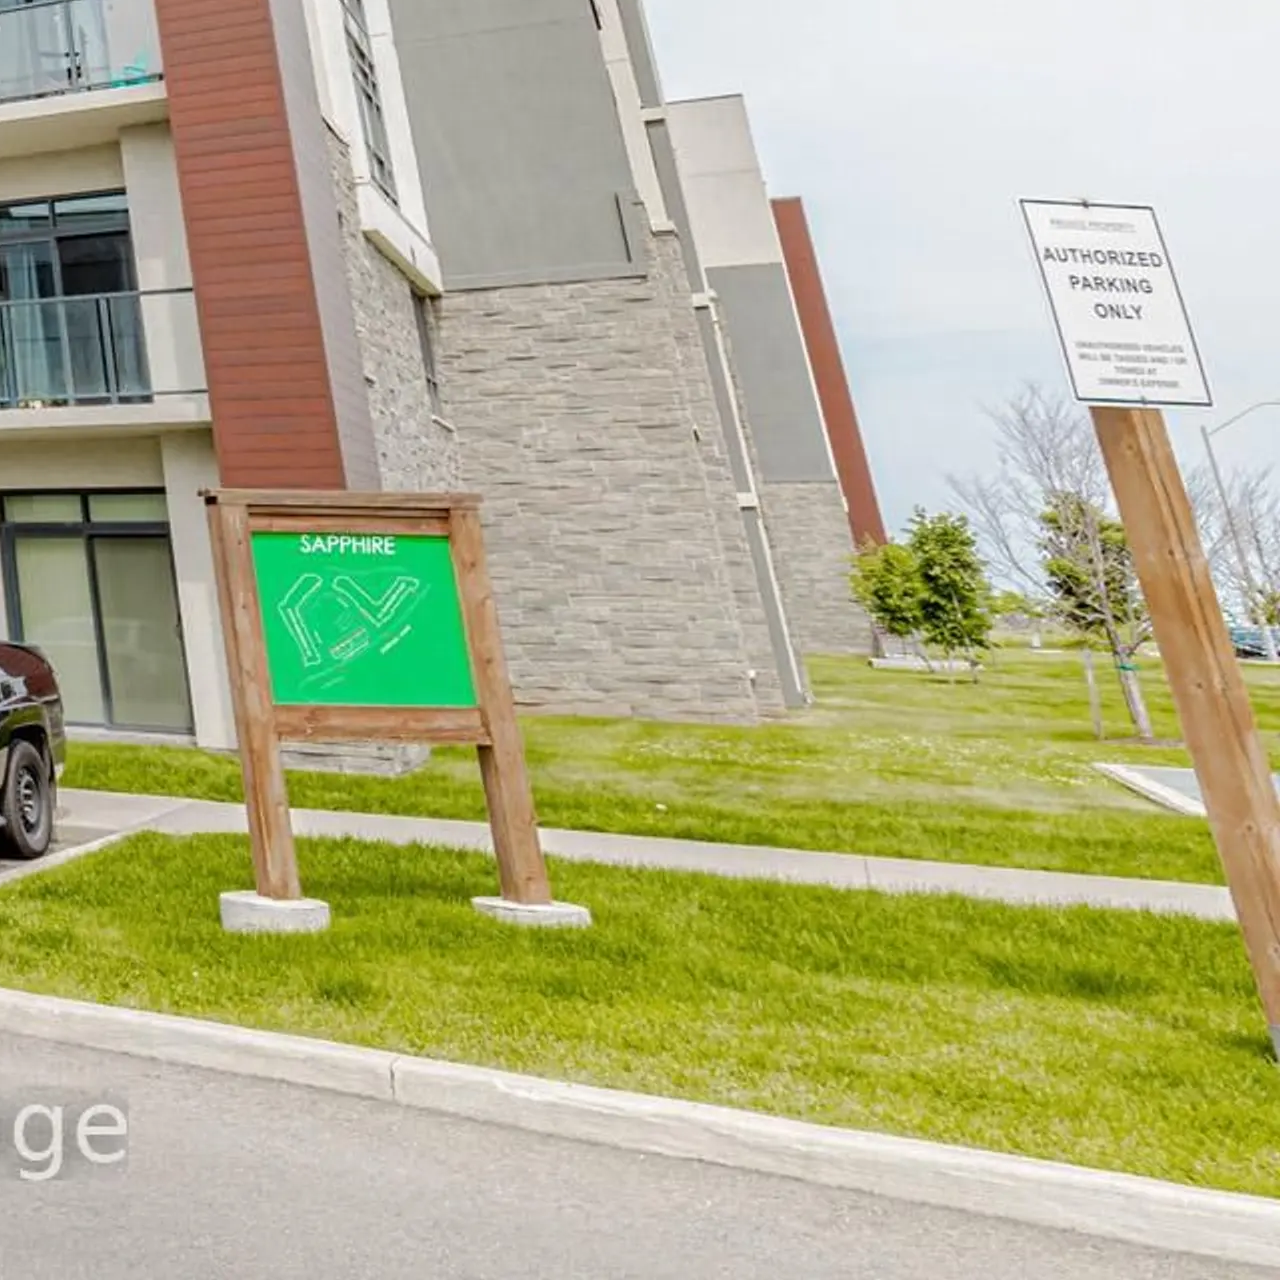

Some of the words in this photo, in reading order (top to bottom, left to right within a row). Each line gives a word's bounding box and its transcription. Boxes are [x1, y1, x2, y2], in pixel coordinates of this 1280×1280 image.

[1043, 246, 1164, 268] AUTHORIZED
[1069, 274, 1154, 295] PARKING
[1093, 302, 1143, 320] ONLY
[300, 534, 396, 555] SAPPHIRE
